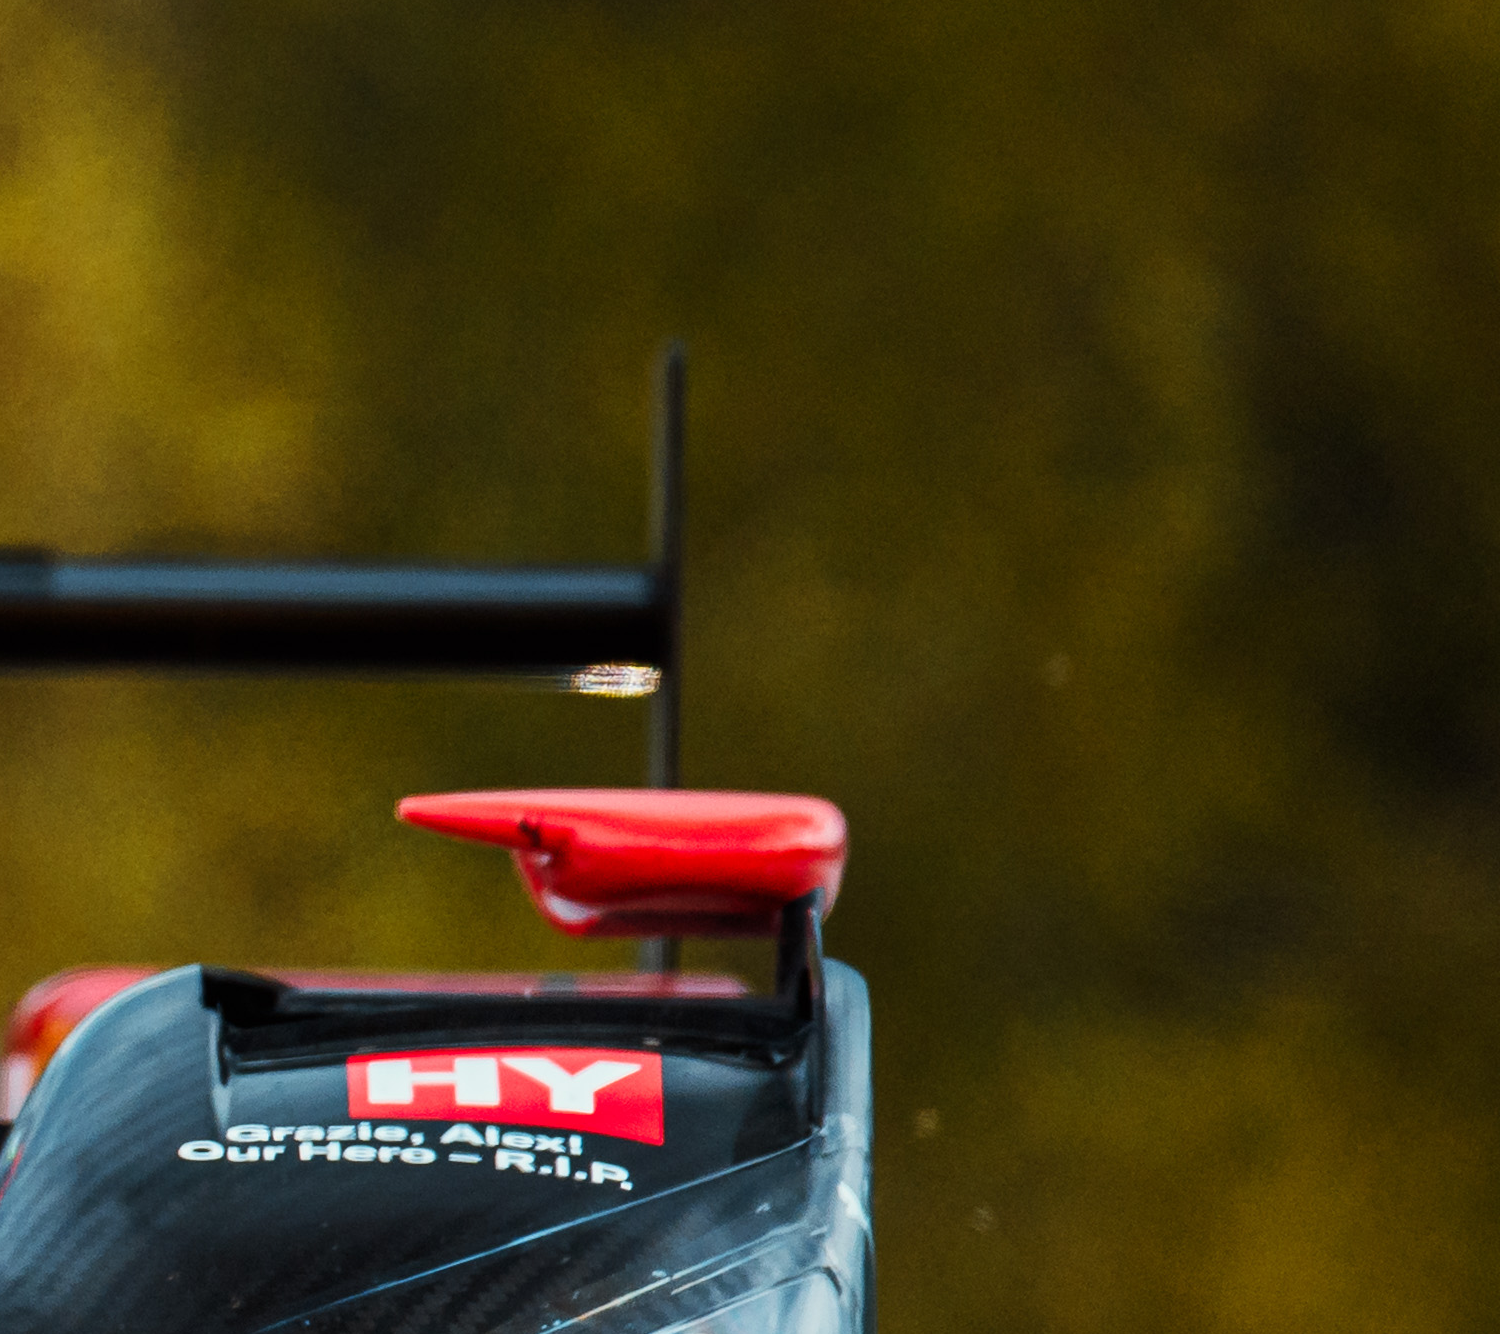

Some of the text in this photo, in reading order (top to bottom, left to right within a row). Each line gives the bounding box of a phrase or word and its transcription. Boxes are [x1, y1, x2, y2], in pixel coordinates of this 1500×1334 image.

[366, 1056, 642, 1115] HY
[226, 1121, 584, 1155] Grazie, Alex!
[177, 1139, 286, 1163] Our
[298, 1141, 437, 1165] Hero
[494, 1147, 635, 1191] R.I.P.
